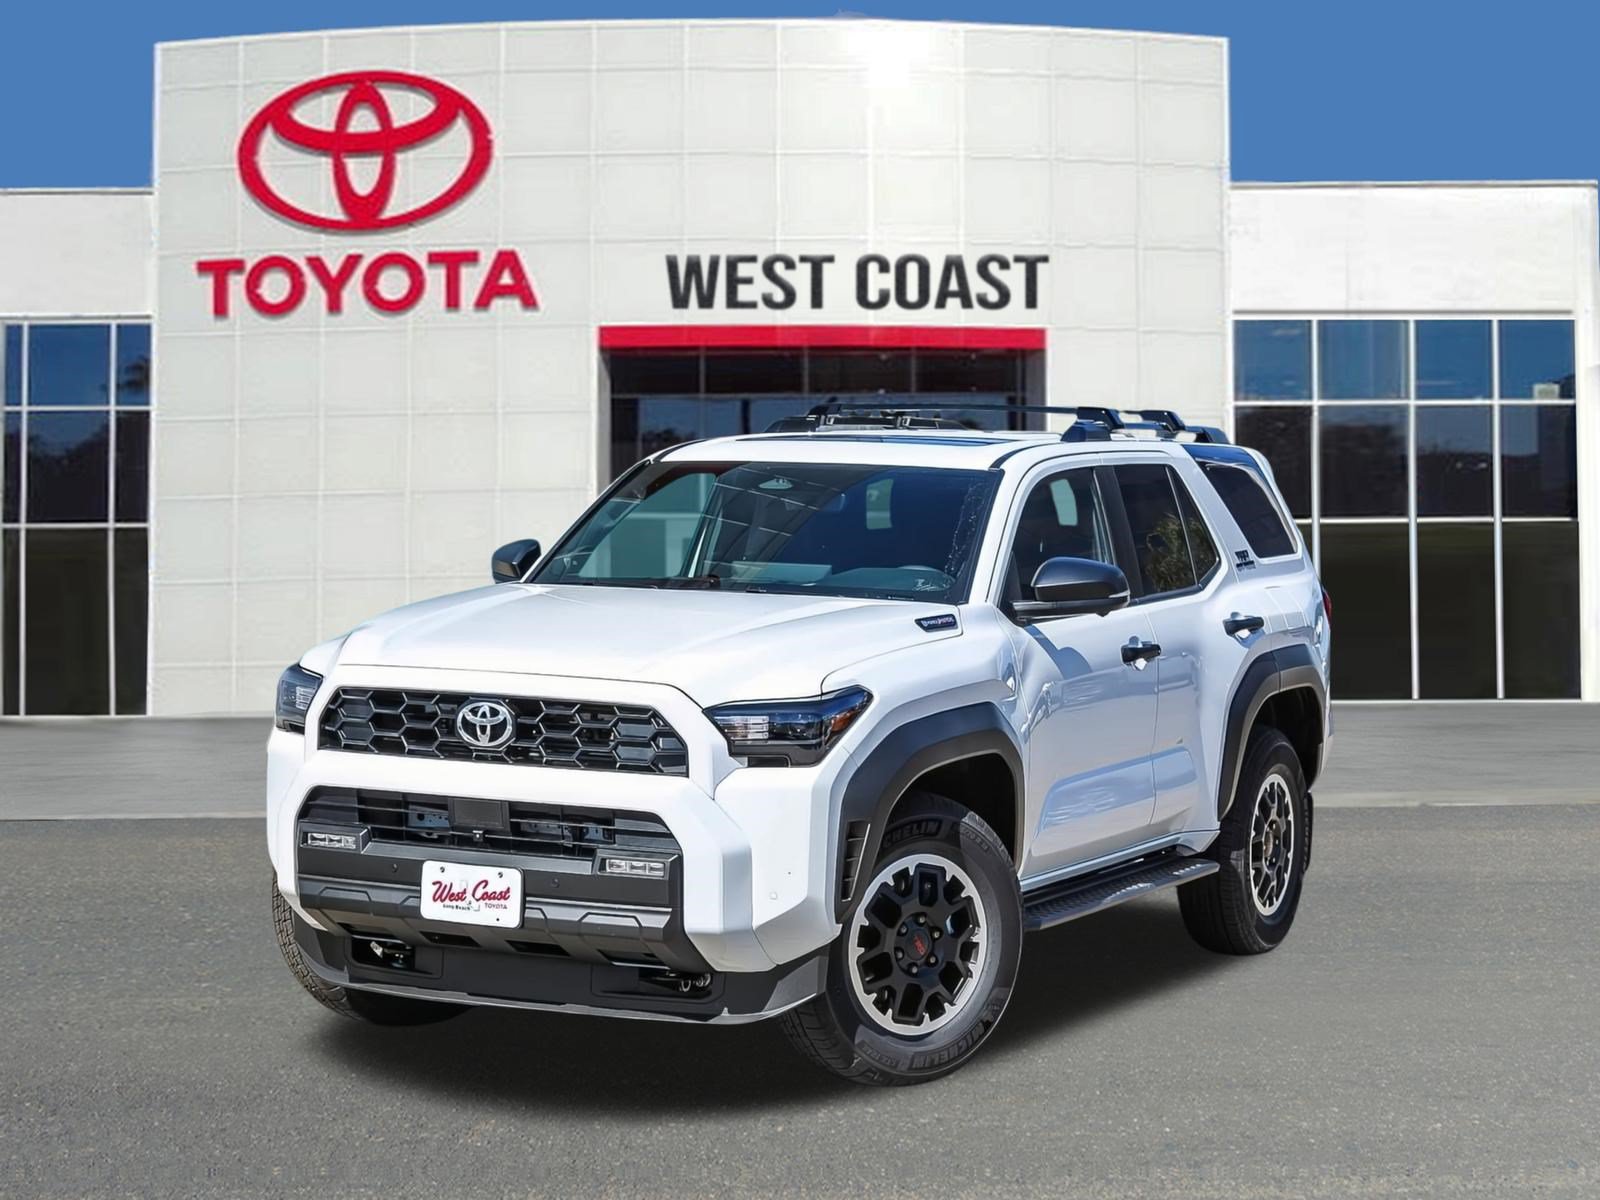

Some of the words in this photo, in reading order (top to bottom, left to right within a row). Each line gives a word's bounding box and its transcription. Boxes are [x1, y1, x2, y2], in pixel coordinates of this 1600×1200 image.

[196, 249, 539, 317] TOYOTA
[665, 254, 835, 310] WEST
[855, 253, 1050, 311] COAST
[432, 881, 468, 903] West
[472, 880, 511, 902] Coast
[484, 902, 508, 910] TOYOTA
